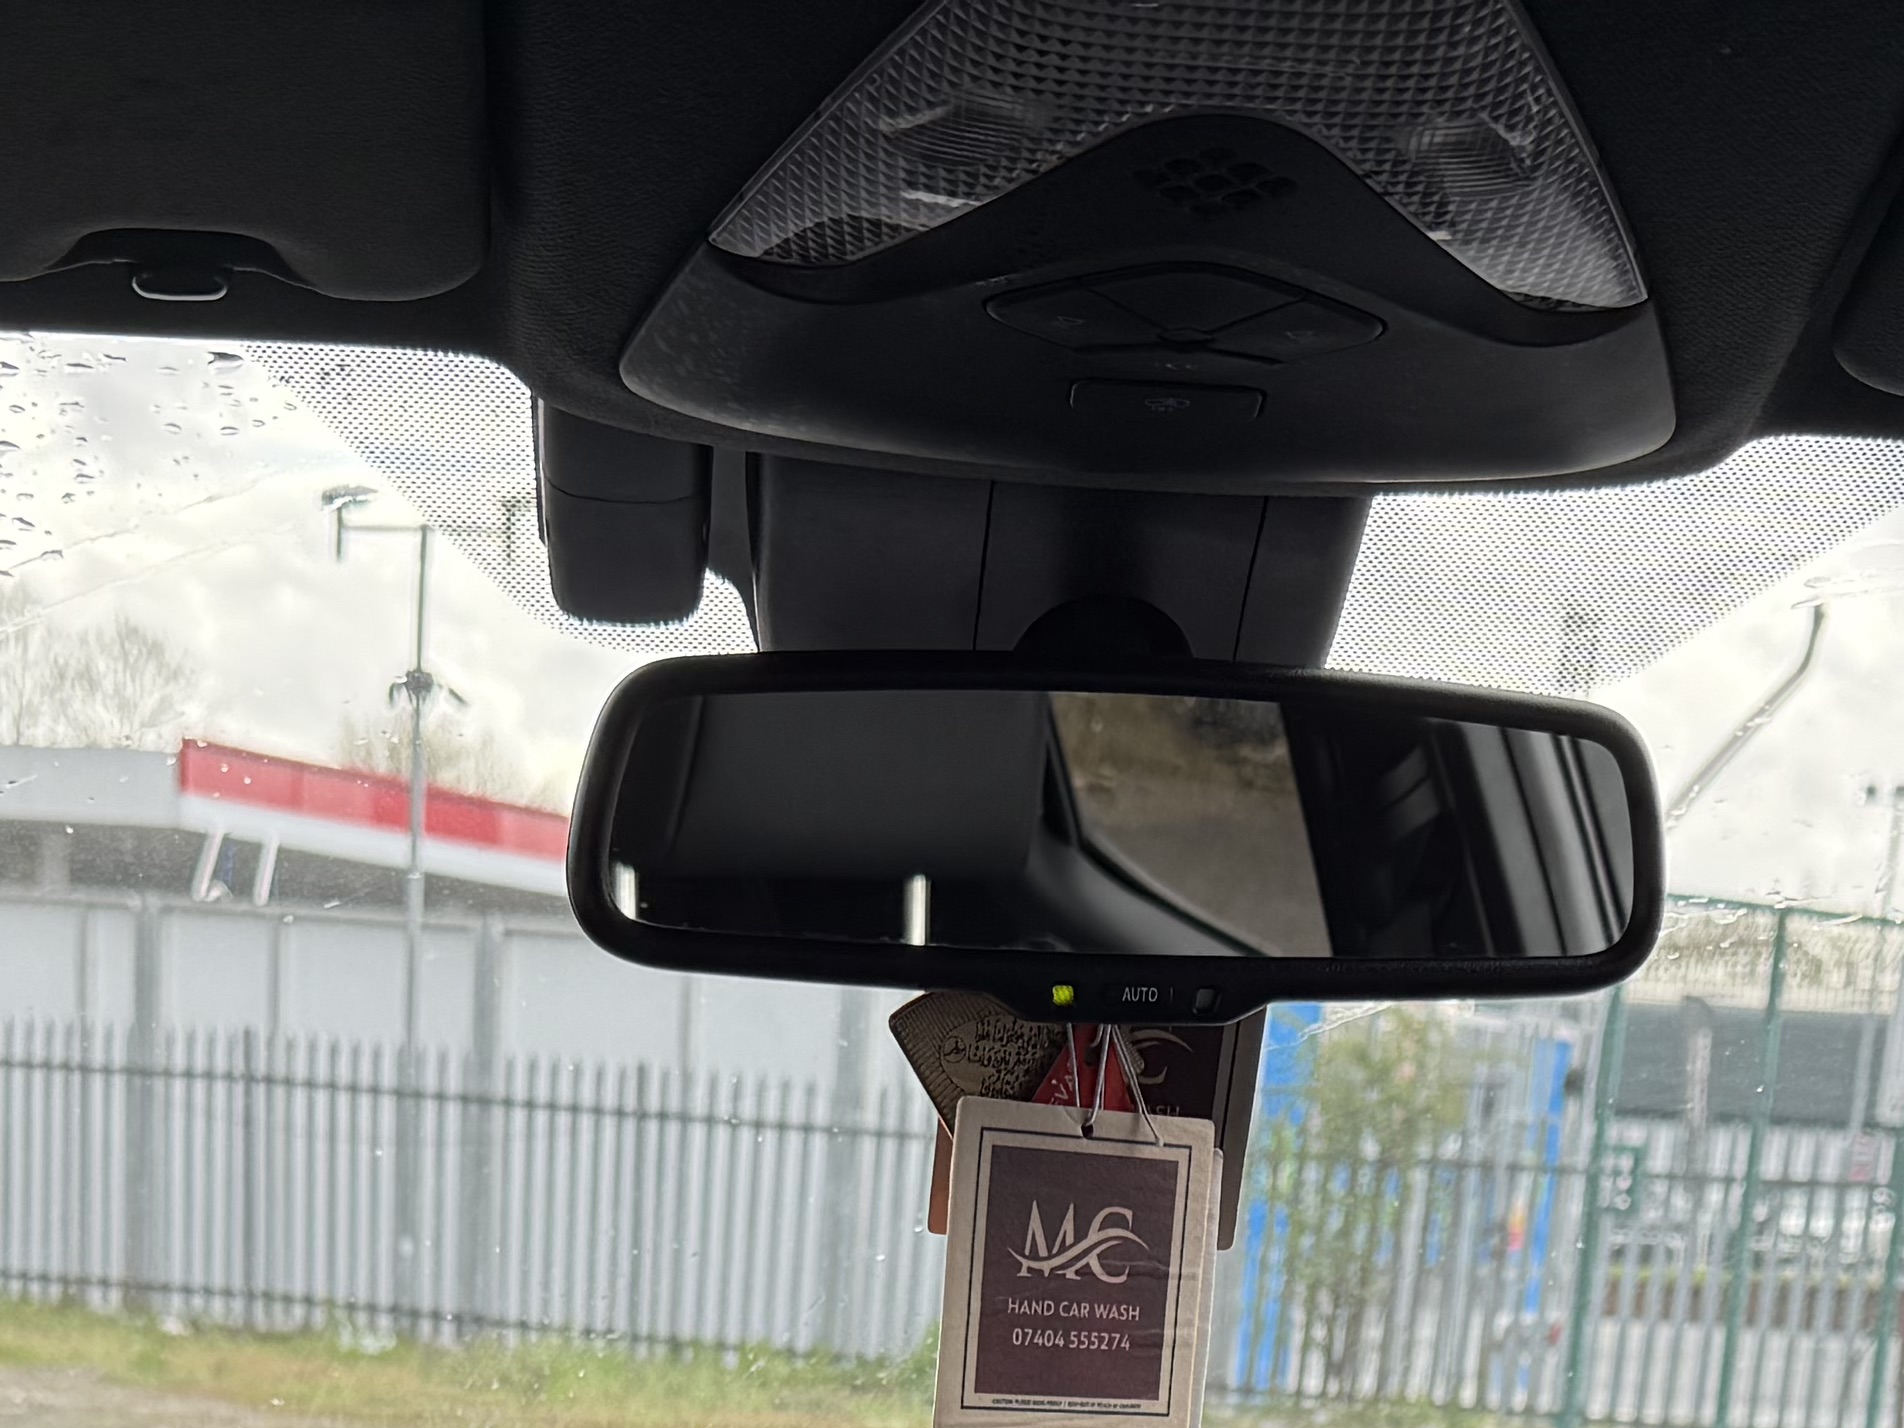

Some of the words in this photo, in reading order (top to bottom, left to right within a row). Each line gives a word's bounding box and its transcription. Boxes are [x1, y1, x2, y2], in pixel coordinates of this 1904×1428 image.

[1121, 986, 1159, 1003] AUTO
[1007, 1298, 1055, 1317] HAND
[1059, 1301, 1089, 1318] CAR
[1094, 1304, 1140, 1321] WASH
[1012, 1328, 1065, 1348] 07404
[1069, 1331, 1131, 1352] 555274
